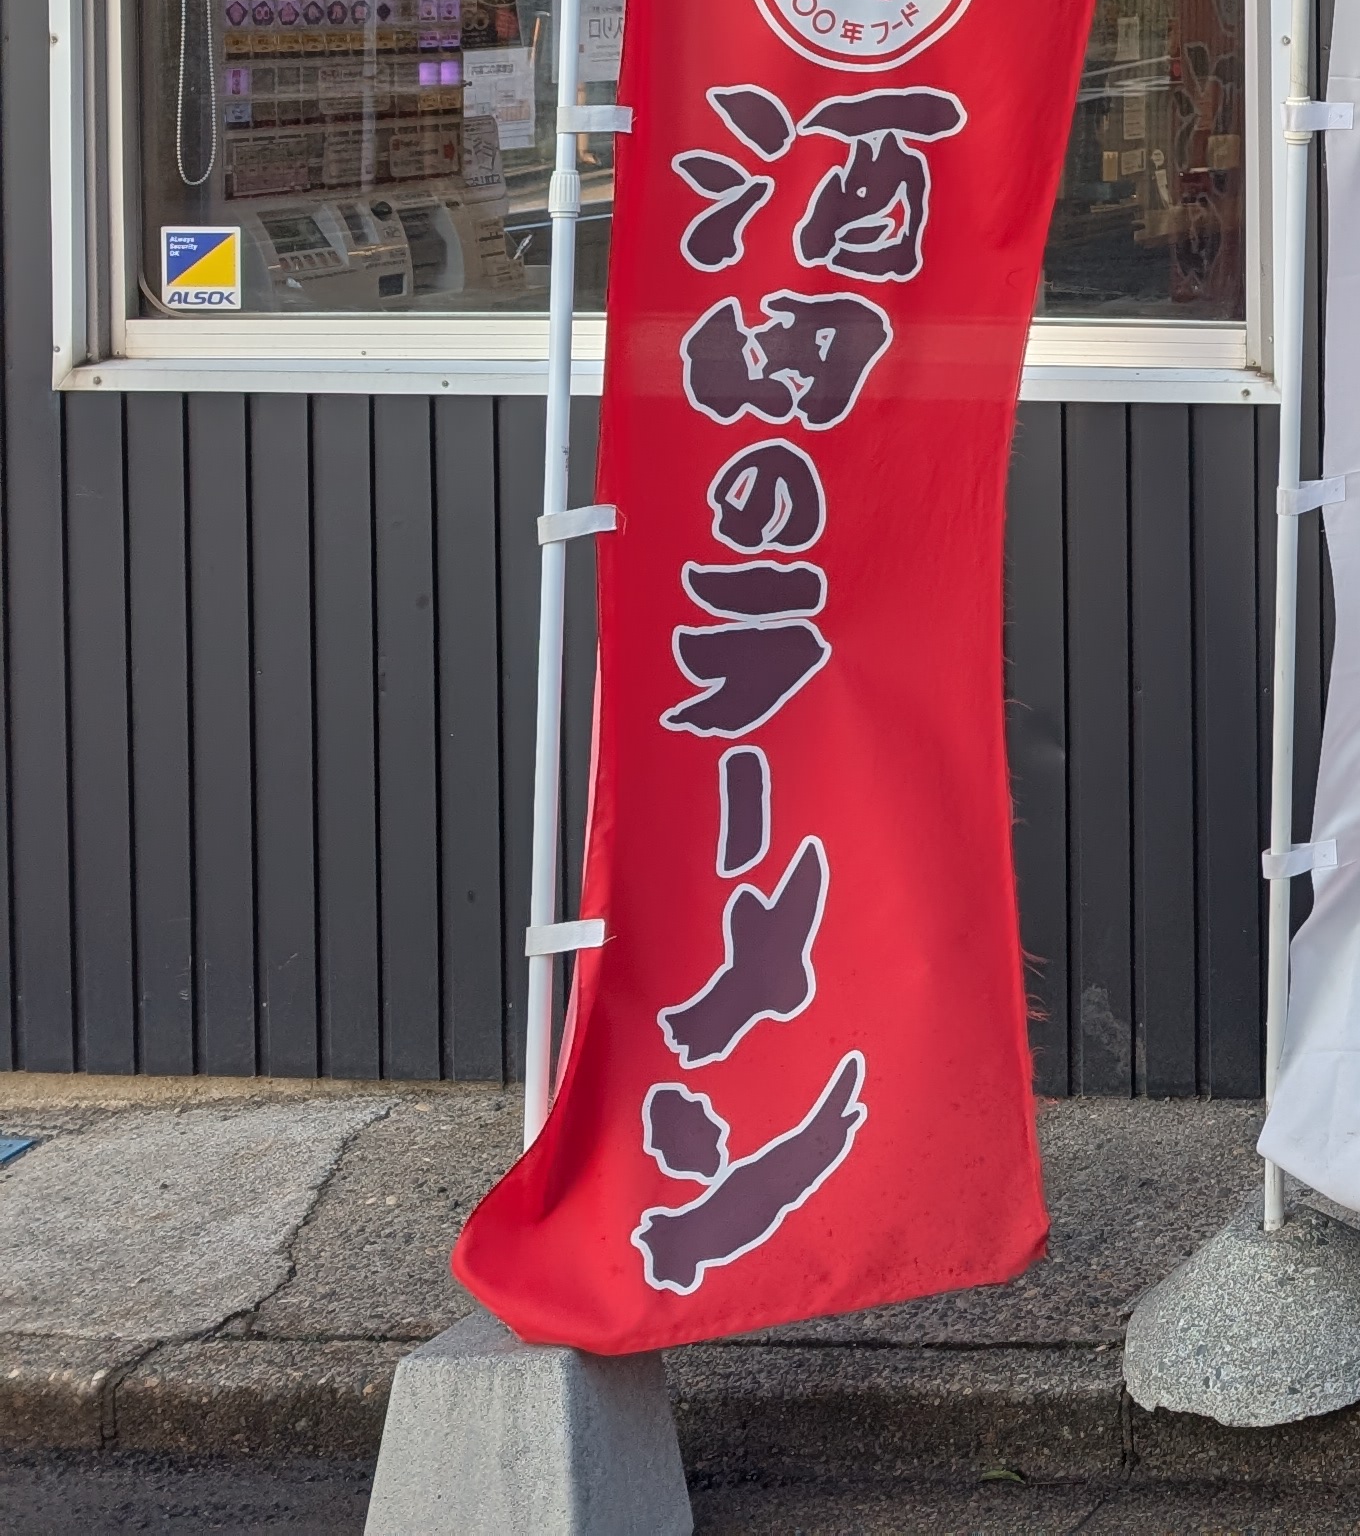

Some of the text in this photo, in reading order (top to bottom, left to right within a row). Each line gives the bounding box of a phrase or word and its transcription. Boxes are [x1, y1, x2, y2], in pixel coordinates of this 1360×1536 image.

[167, 291, 236, 305] ALSOK
[631, 85, 968, 1295] 酒田のラーメン
